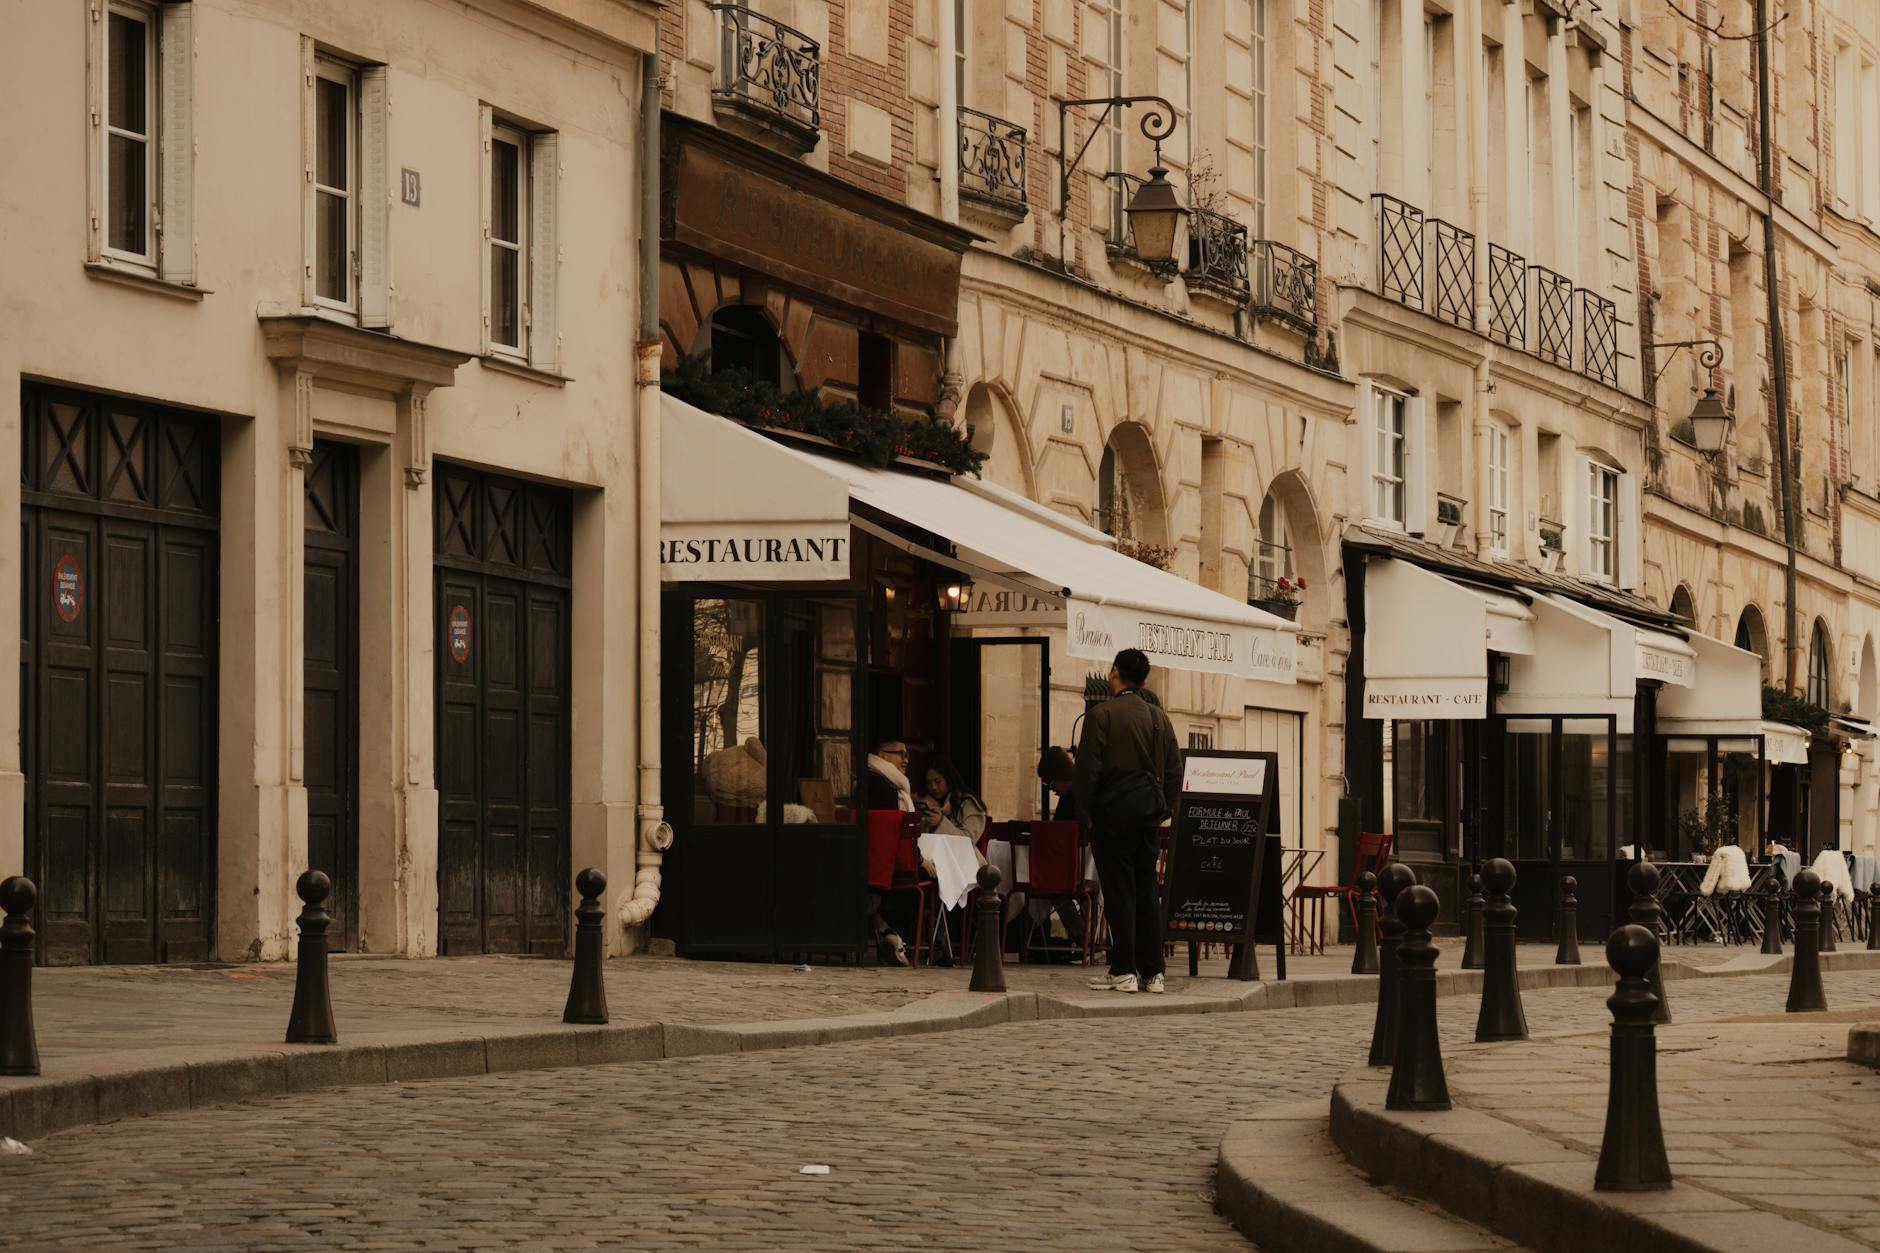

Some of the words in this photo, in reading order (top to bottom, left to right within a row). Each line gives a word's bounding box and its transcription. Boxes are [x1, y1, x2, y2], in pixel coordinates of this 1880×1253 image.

[404, 173, 417, 202] 13
[715, 171, 930, 293] RESTAURANT
[1138, 622, 1205, 659] RESTAURANT
[1207, 631, 1233, 662] PAUL
[1368, 694, 1442, 705] RESTAURANT
[1188, 806, 1223, 818] FORMULE
